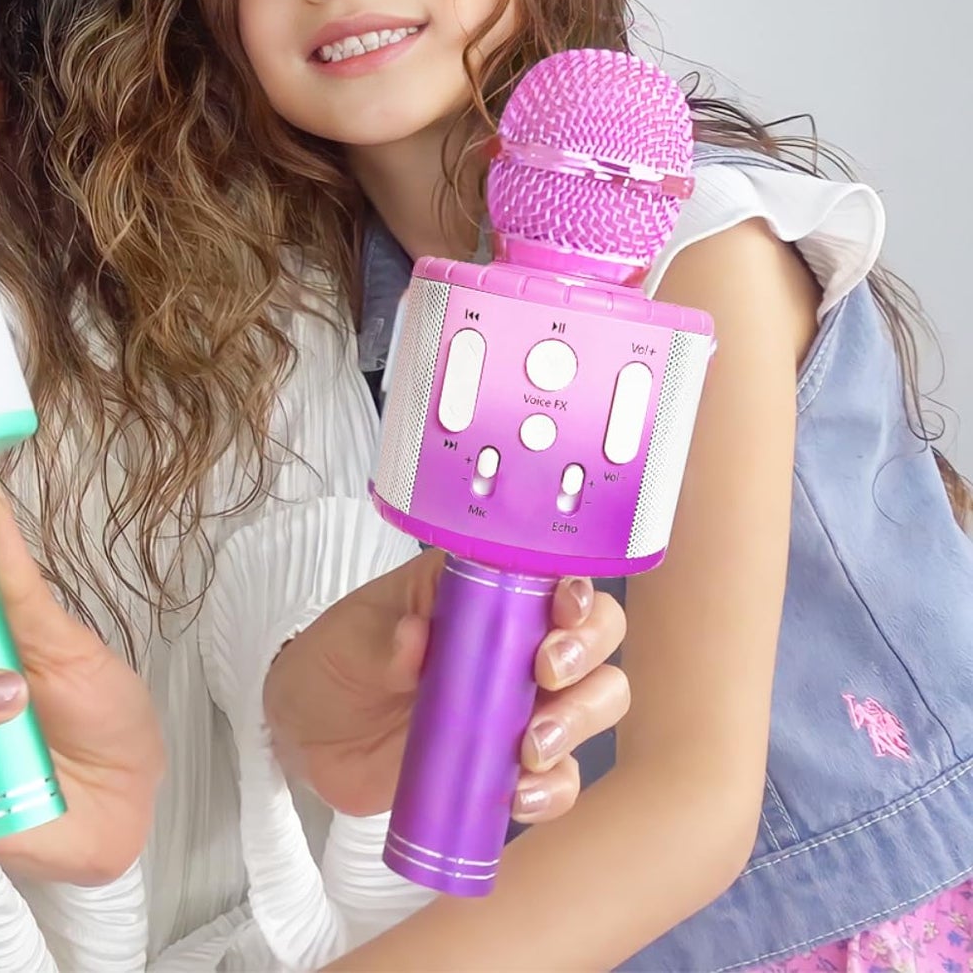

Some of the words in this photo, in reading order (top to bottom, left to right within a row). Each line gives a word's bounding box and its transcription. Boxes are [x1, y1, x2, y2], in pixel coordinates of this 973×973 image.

[523, 393, 552, 409] Voice
[554, 399, 568, 412] FX
[467, 504, 488, 518] Mic
[551, 521, 579, 534] Echo
